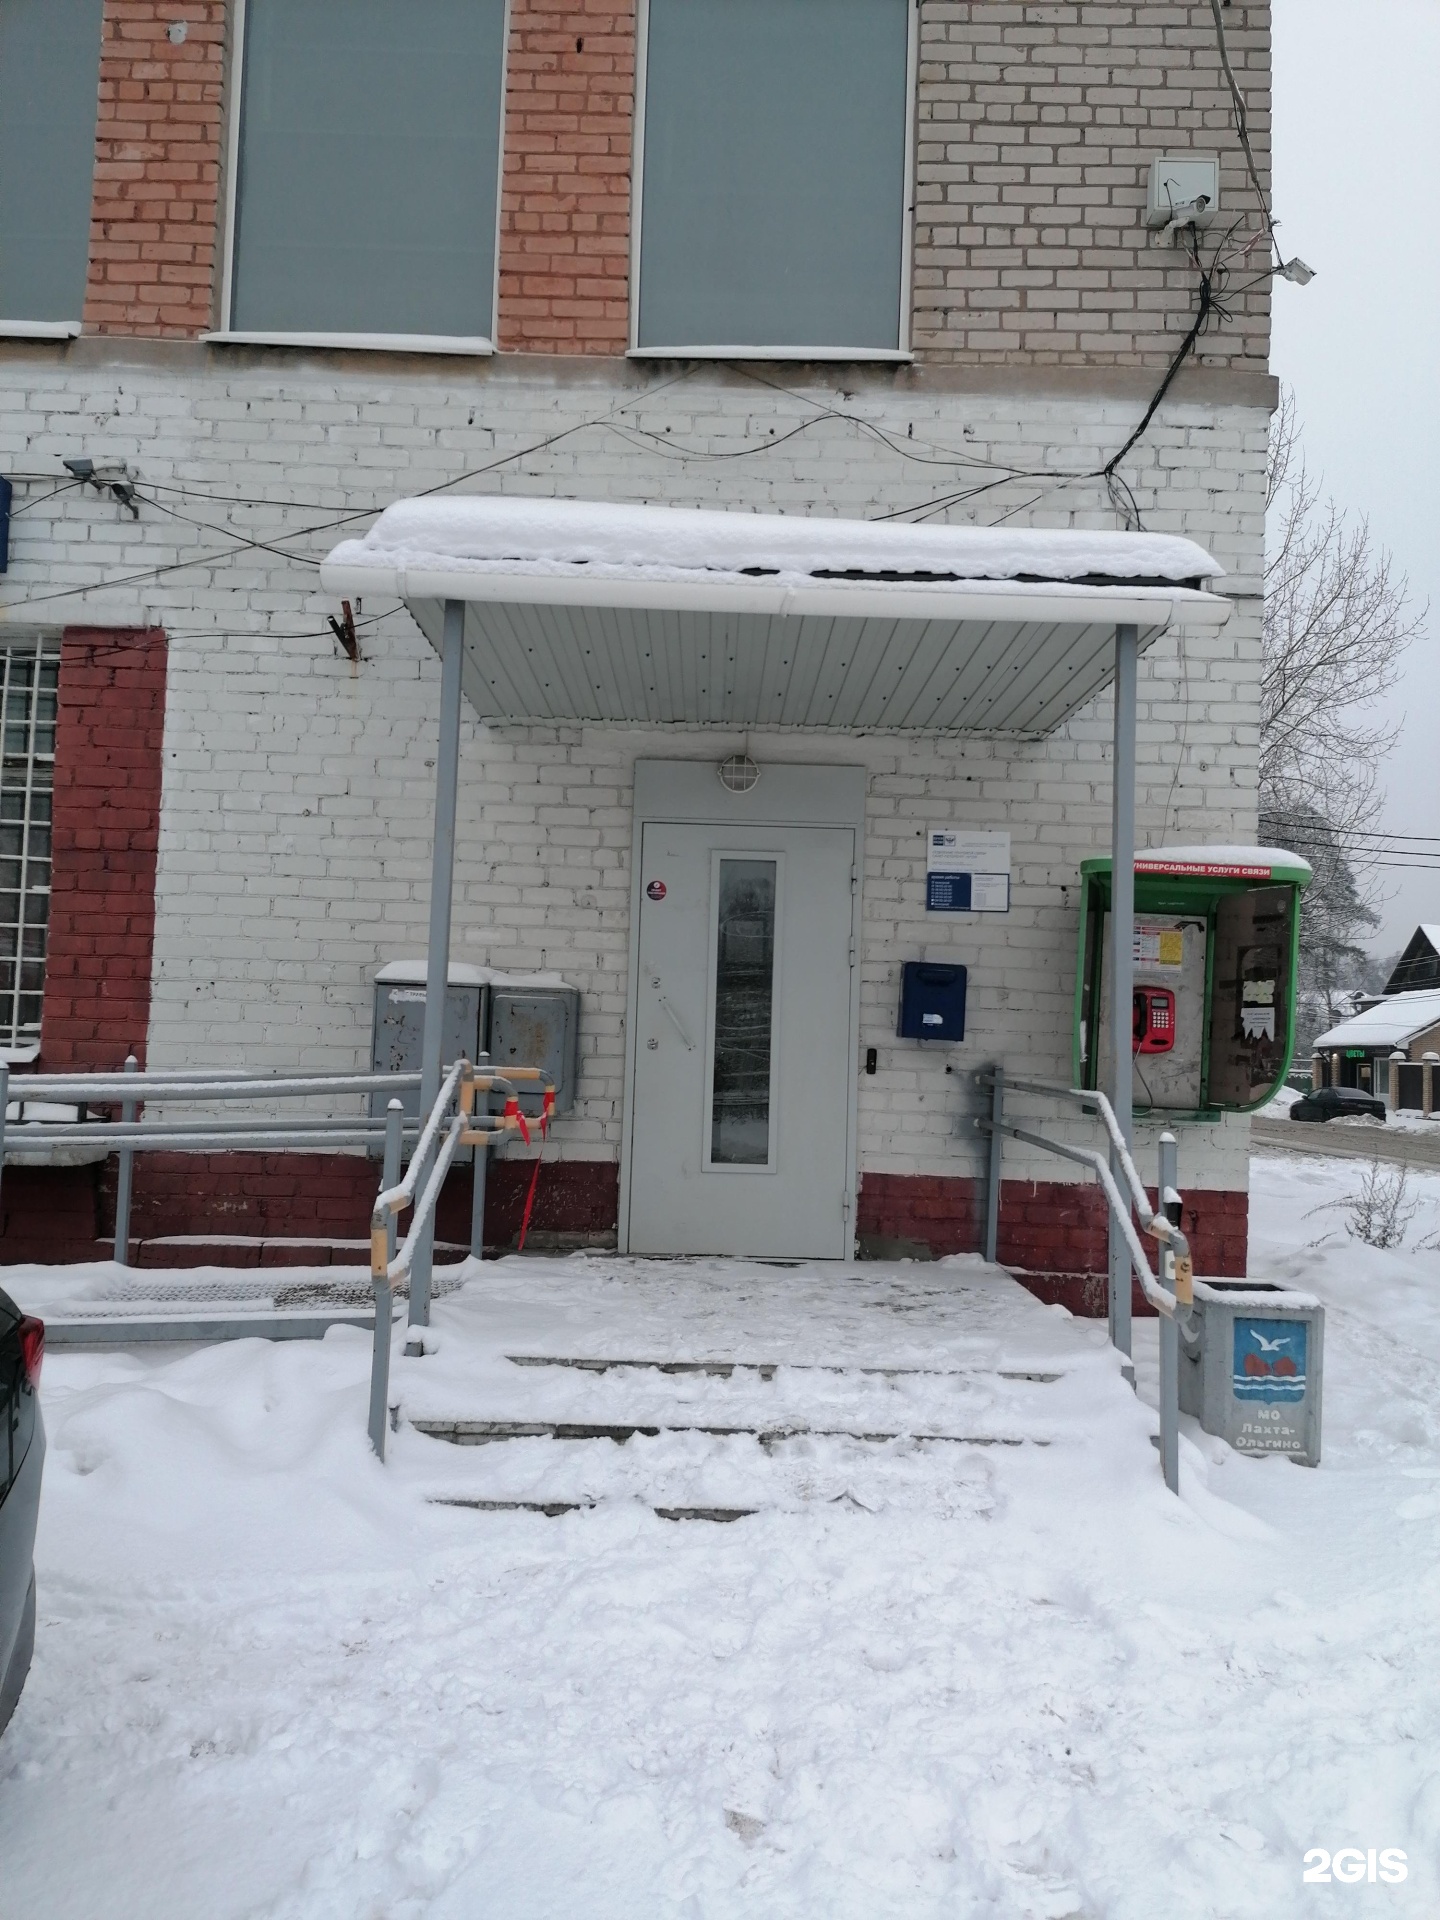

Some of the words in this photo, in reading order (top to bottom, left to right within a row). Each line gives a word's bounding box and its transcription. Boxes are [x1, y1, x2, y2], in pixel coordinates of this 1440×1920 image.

[1207, 866, 1240, 874] УСЛУГИ
[1241, 868, 1270, 876] СВЯЗИ
[1257, 1409, 1281, 1420] МО
[1241, 1423, 1296, 1435] Лахта-
[1235, 1436, 1301, 1449] Ольгино
